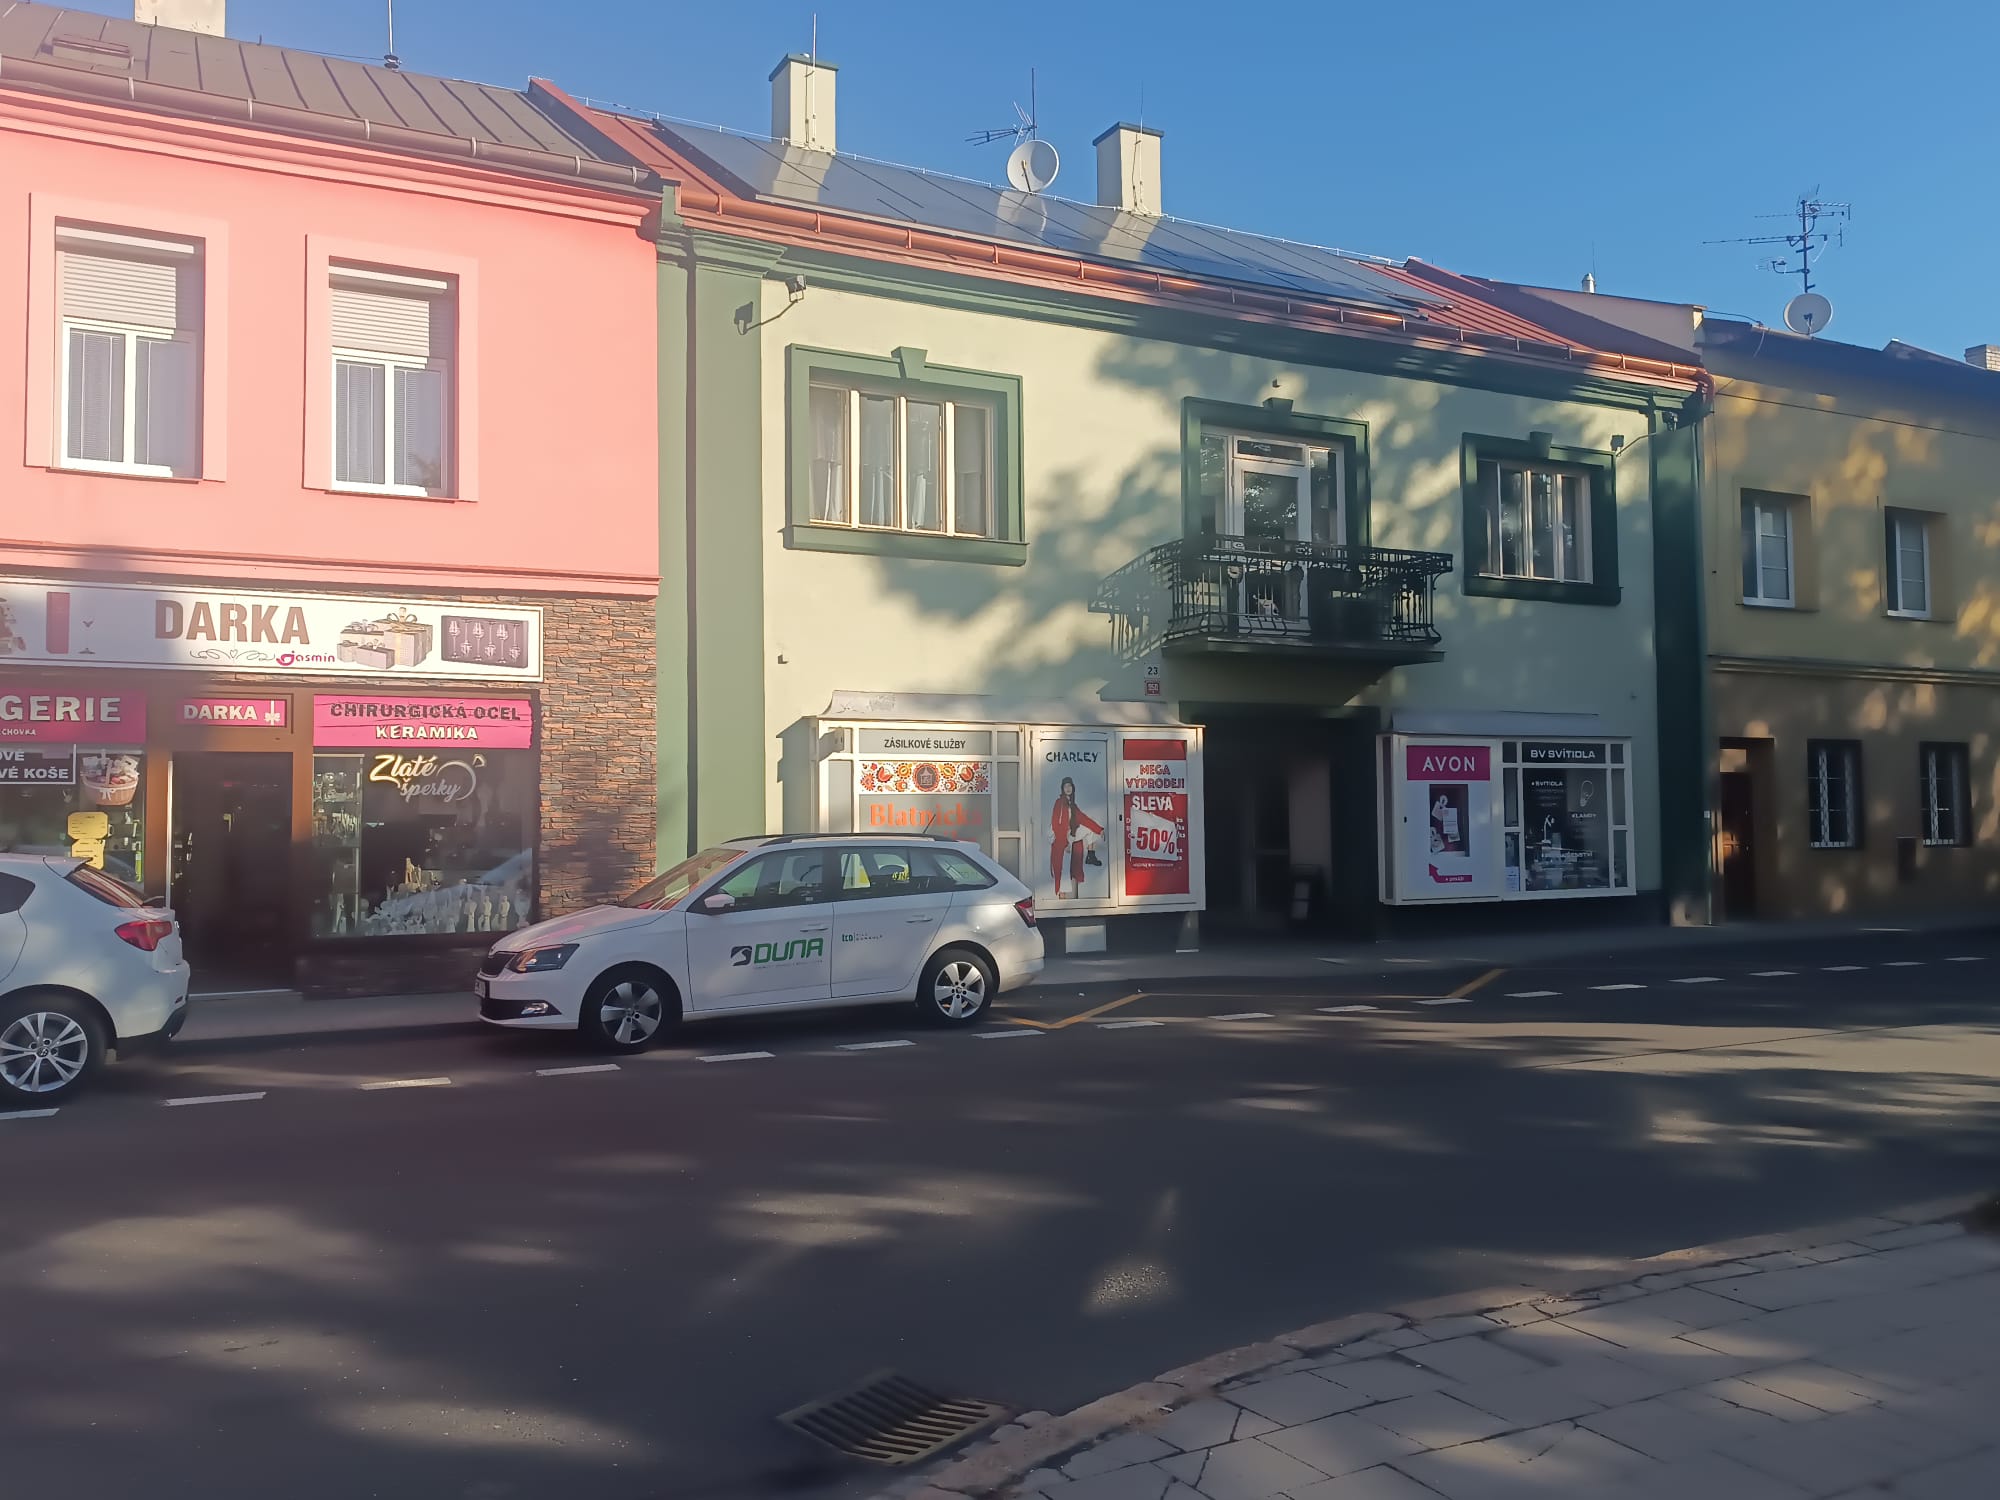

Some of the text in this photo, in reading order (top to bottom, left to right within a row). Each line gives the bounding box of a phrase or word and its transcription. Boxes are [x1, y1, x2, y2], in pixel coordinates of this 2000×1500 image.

[155, 599, 310, 645] DARKA
[1147, 666, 1159, 675] 23
[0, 695, 121, 721] GERIE
[183, 704, 258, 721] DARKA
[330, 701, 521, 721] CHIRURGICKÁ OCEL
[375, 725, 479, 740] KERAMIKA
[884, 737, 966, 749] ZÁSILKOVÉ SLUŽBY
[1046, 751, 1099, 763] CHARLEY
[1530, 749, 1546, 758] BV
[369, 754, 439, 788] Zlaté
[1140, 764, 1171, 775] MEGA
[1422, 756, 1476, 772] AVON
[24, 766, 69, 779] KOŠE
[400, 776, 462, 803] šperky
[1132, 795, 1174, 811] SLEVA
[754, 938, 823, 964] DUNA
